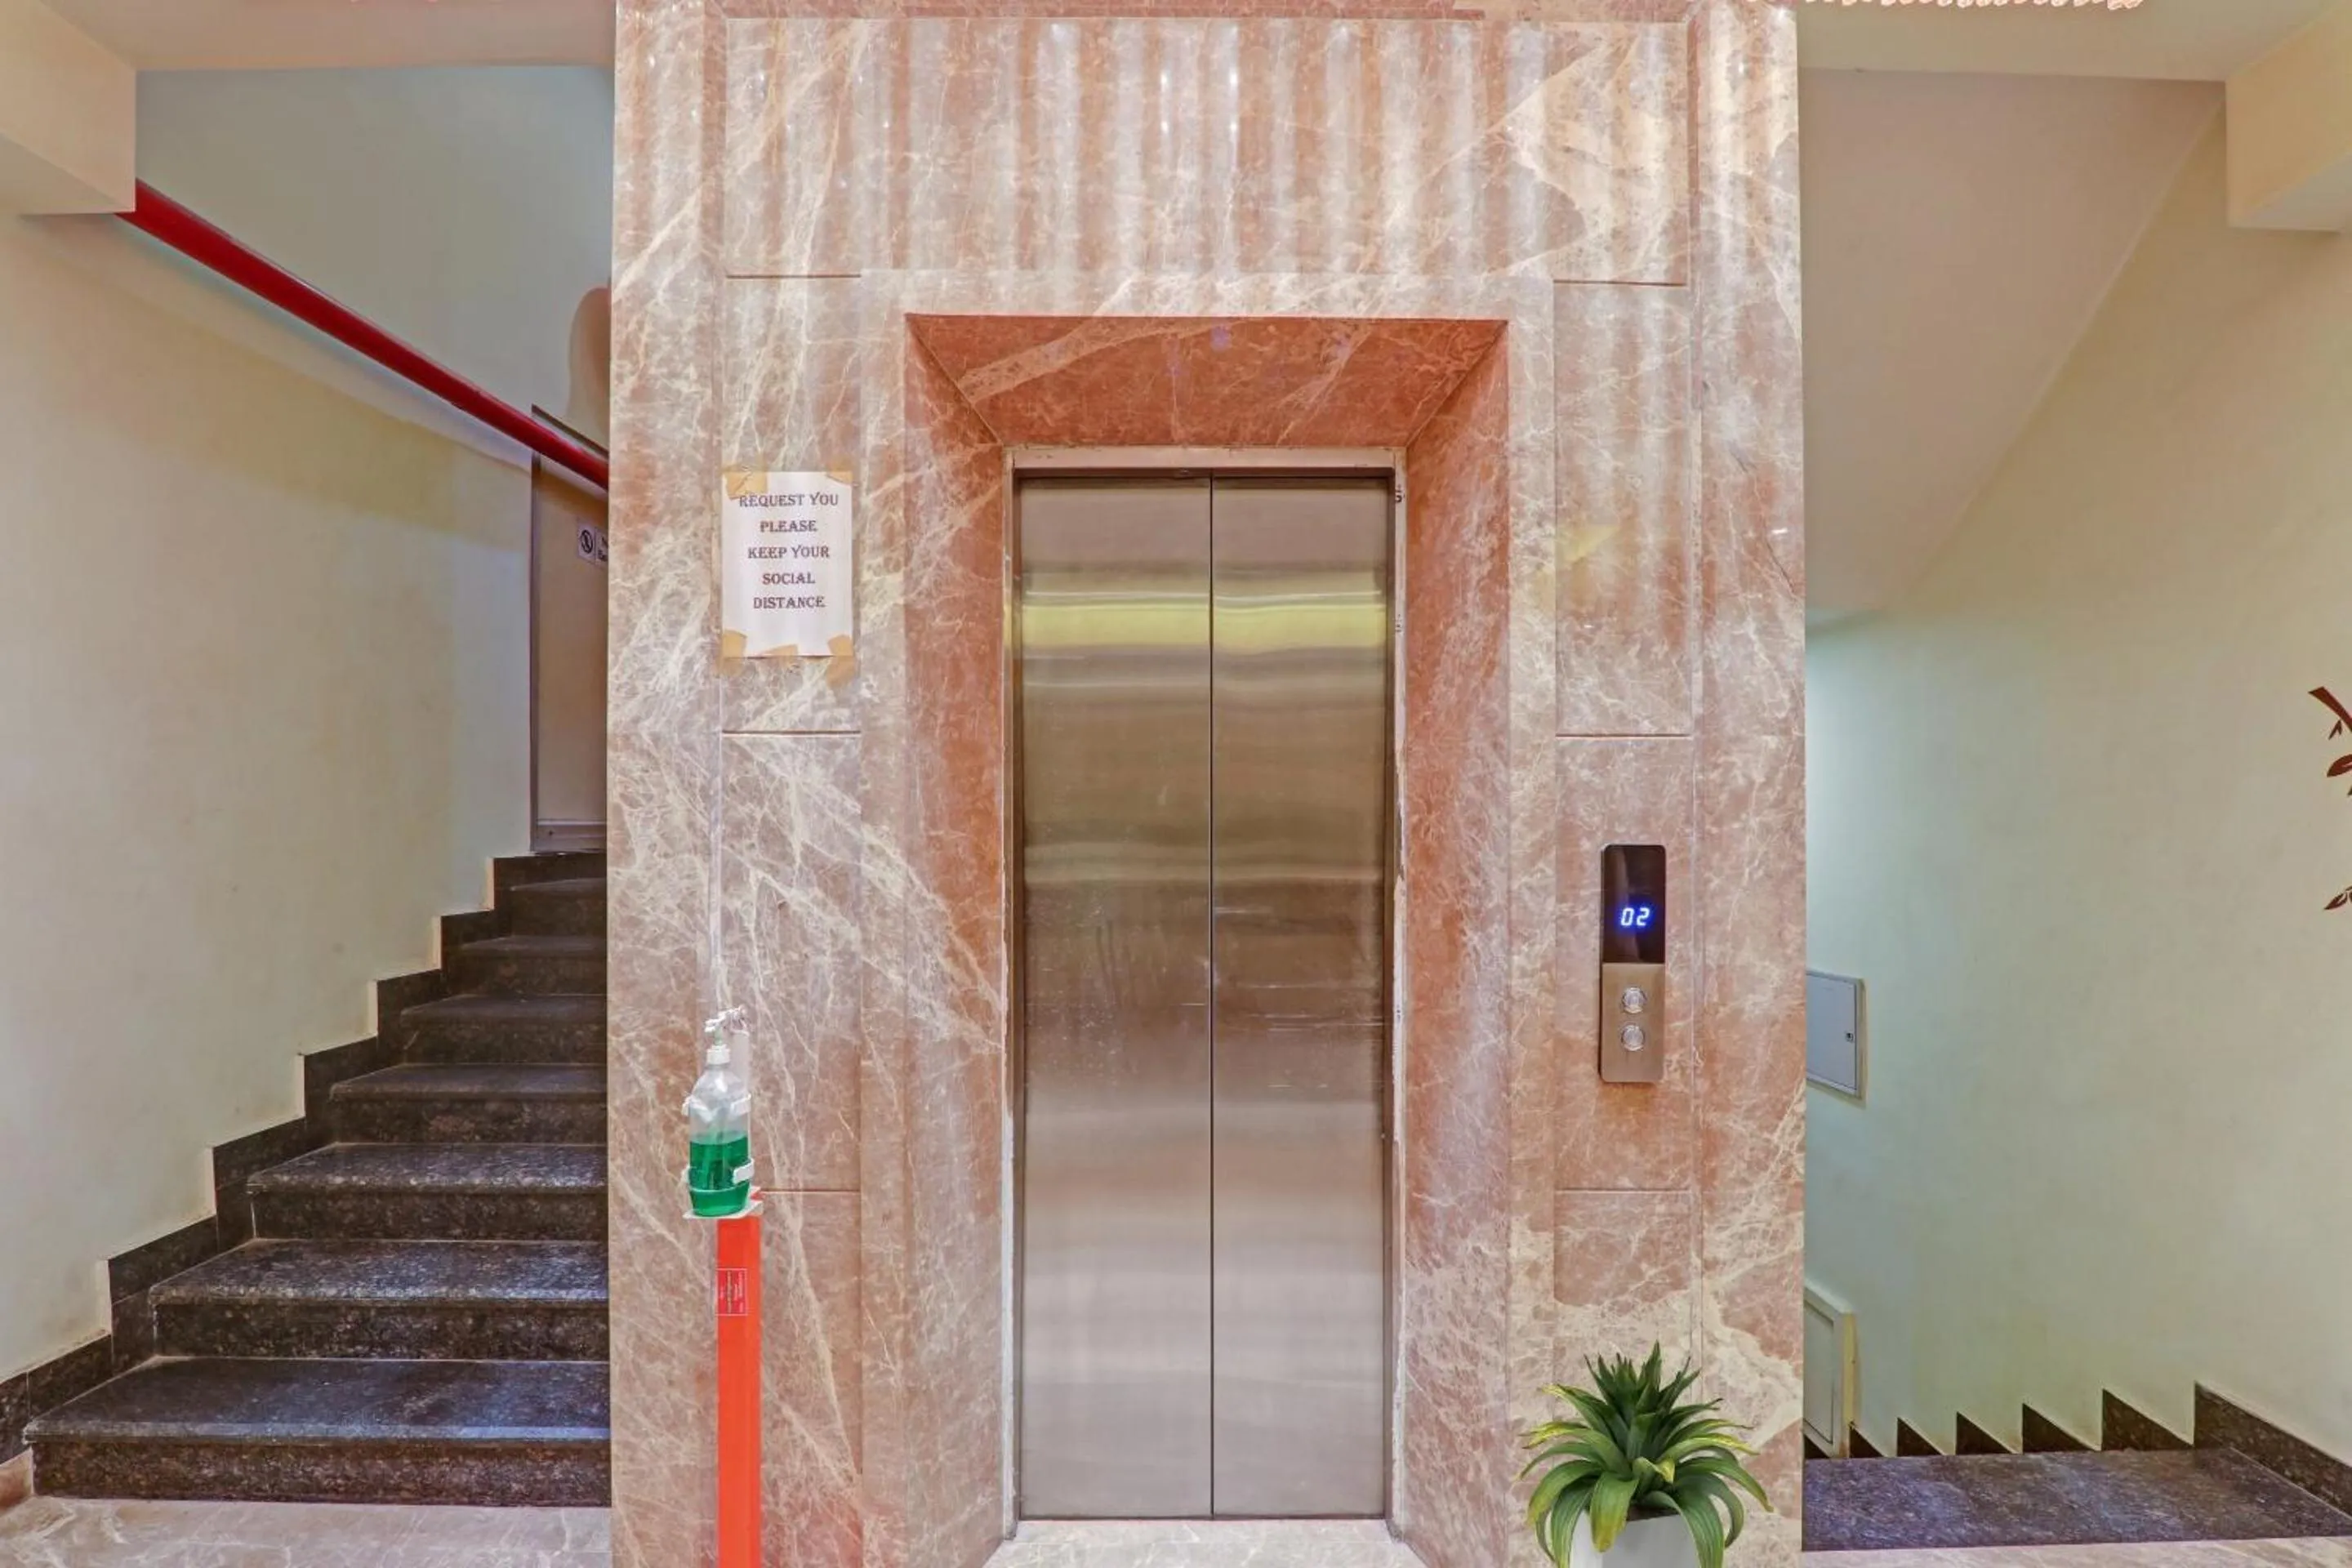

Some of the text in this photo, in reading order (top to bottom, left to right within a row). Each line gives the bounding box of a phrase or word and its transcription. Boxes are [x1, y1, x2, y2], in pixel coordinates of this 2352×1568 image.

[739, 492, 840, 508] REQUEST YOU
[760, 519, 817, 532] PLEASE
[747, 545, 830, 559] KEEP YOUR
[762, 572, 816, 585] SOCIAL
[753, 596, 826, 609] DISTANCE
[1620, 907, 1650, 926] 02
